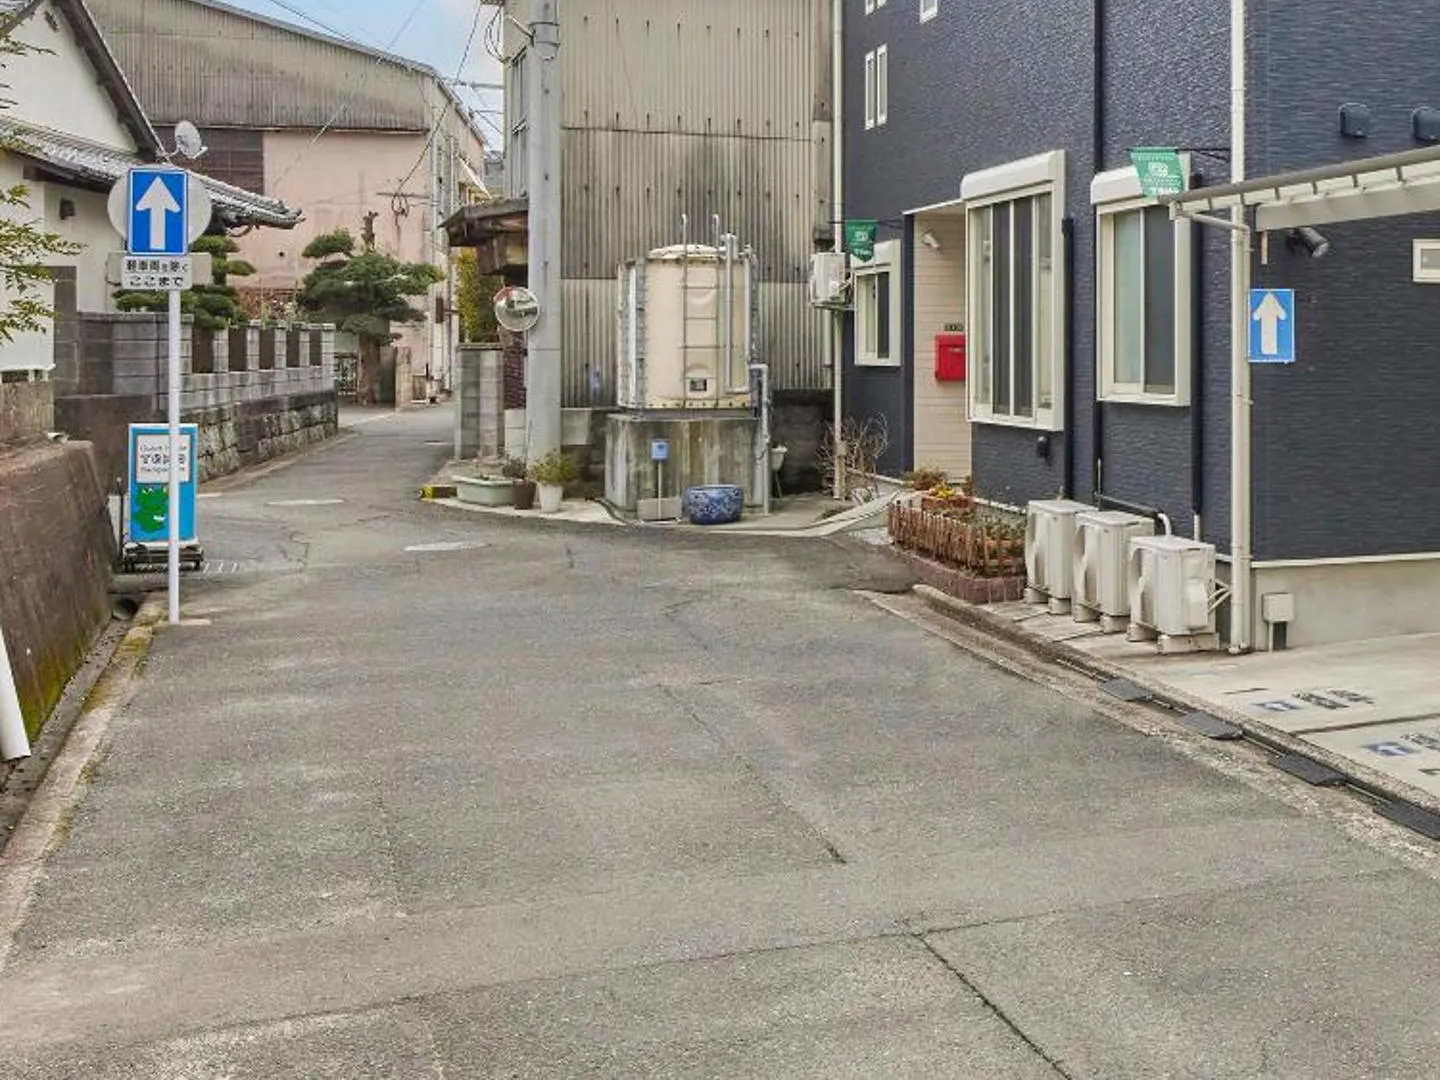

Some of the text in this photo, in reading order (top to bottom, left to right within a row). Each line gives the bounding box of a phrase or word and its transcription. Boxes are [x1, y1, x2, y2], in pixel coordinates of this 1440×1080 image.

[126, 259, 189, 272] 軽車両を除く
[130, 275, 184, 287] ここまで
